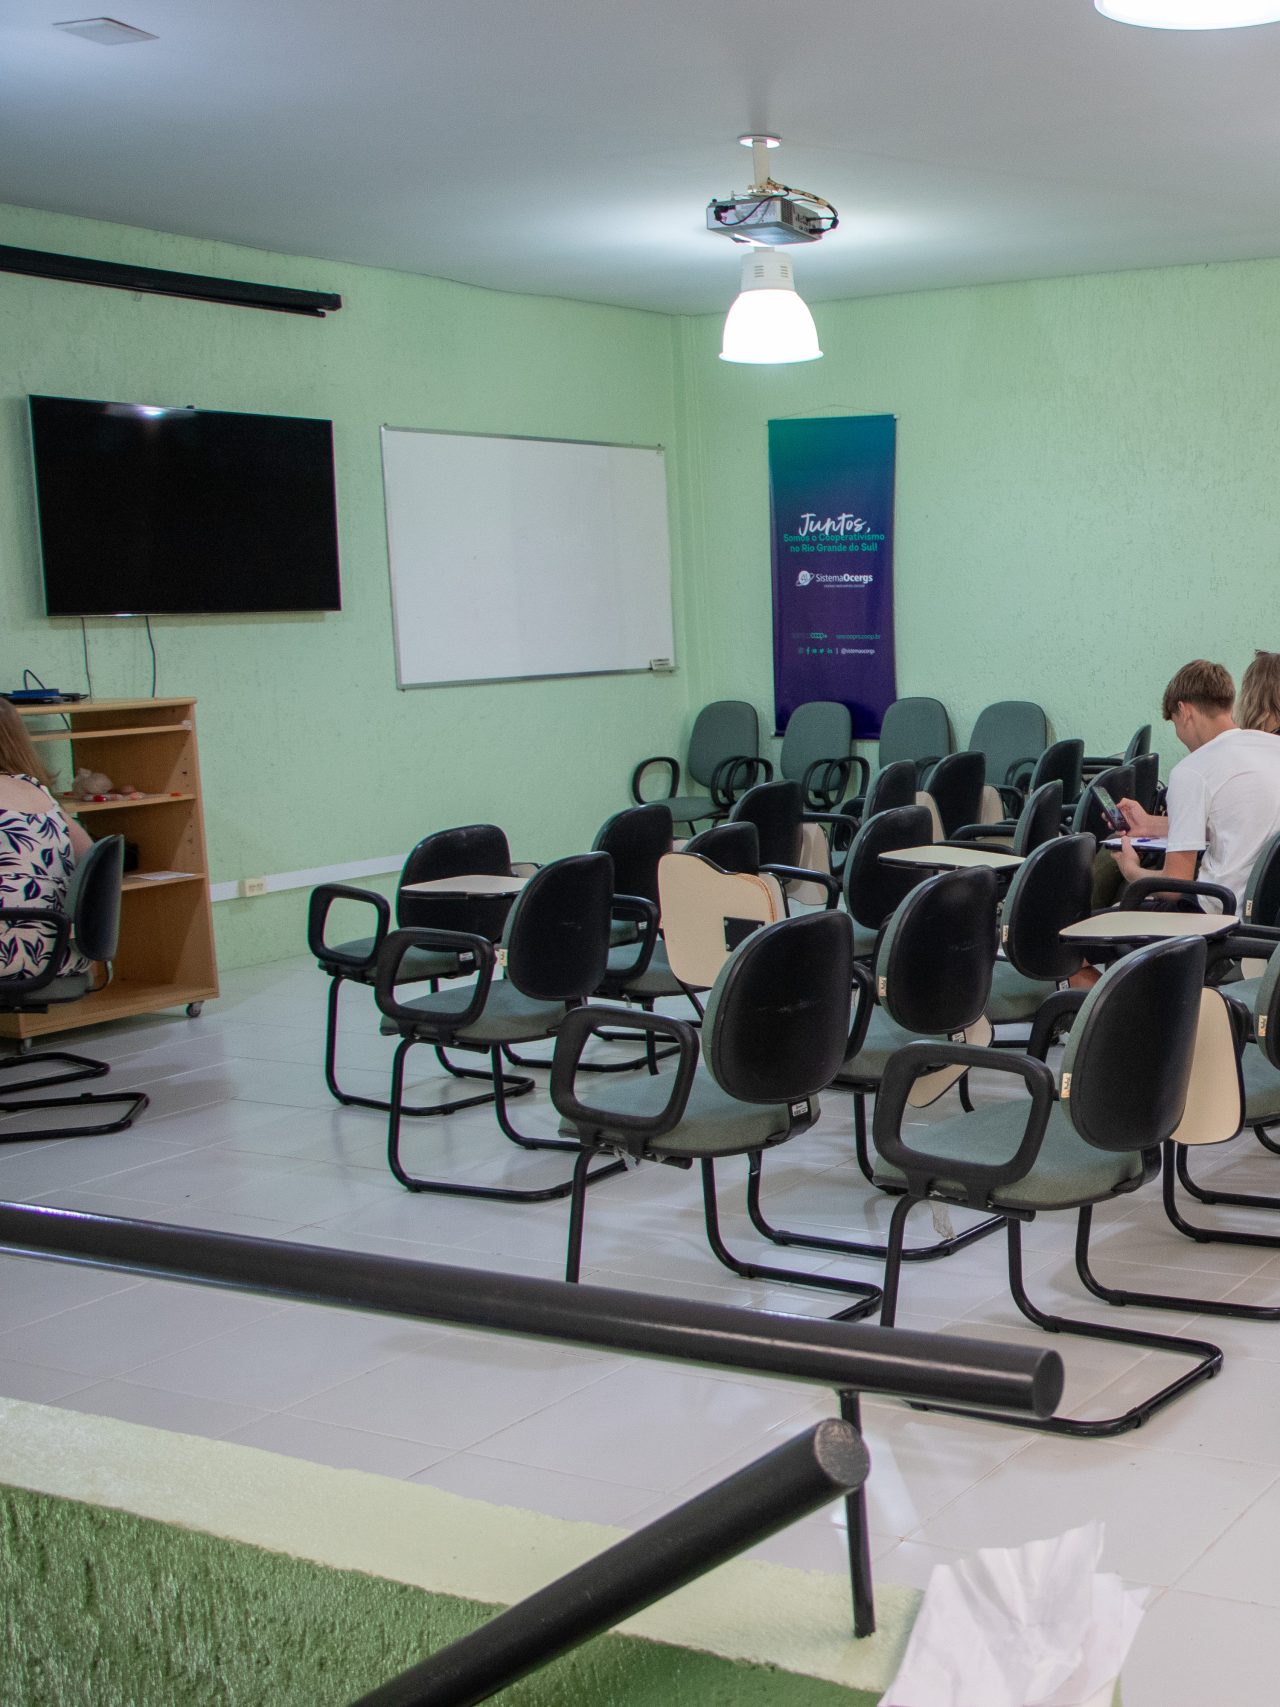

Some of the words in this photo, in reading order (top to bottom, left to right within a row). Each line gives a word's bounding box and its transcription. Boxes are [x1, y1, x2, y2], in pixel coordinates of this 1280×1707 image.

[798, 512, 871, 536] Juntos,
[784, 533, 810, 542] Somos
[819, 533, 885, 543] Cooperativismo
[802, 544, 815, 552] Rio
[817, 543, 847, 552] Grande
[849, 543, 859, 551] do
[861, 542, 878, 551] Sul!
[815, 573, 873, 584] SistemaOcergs
